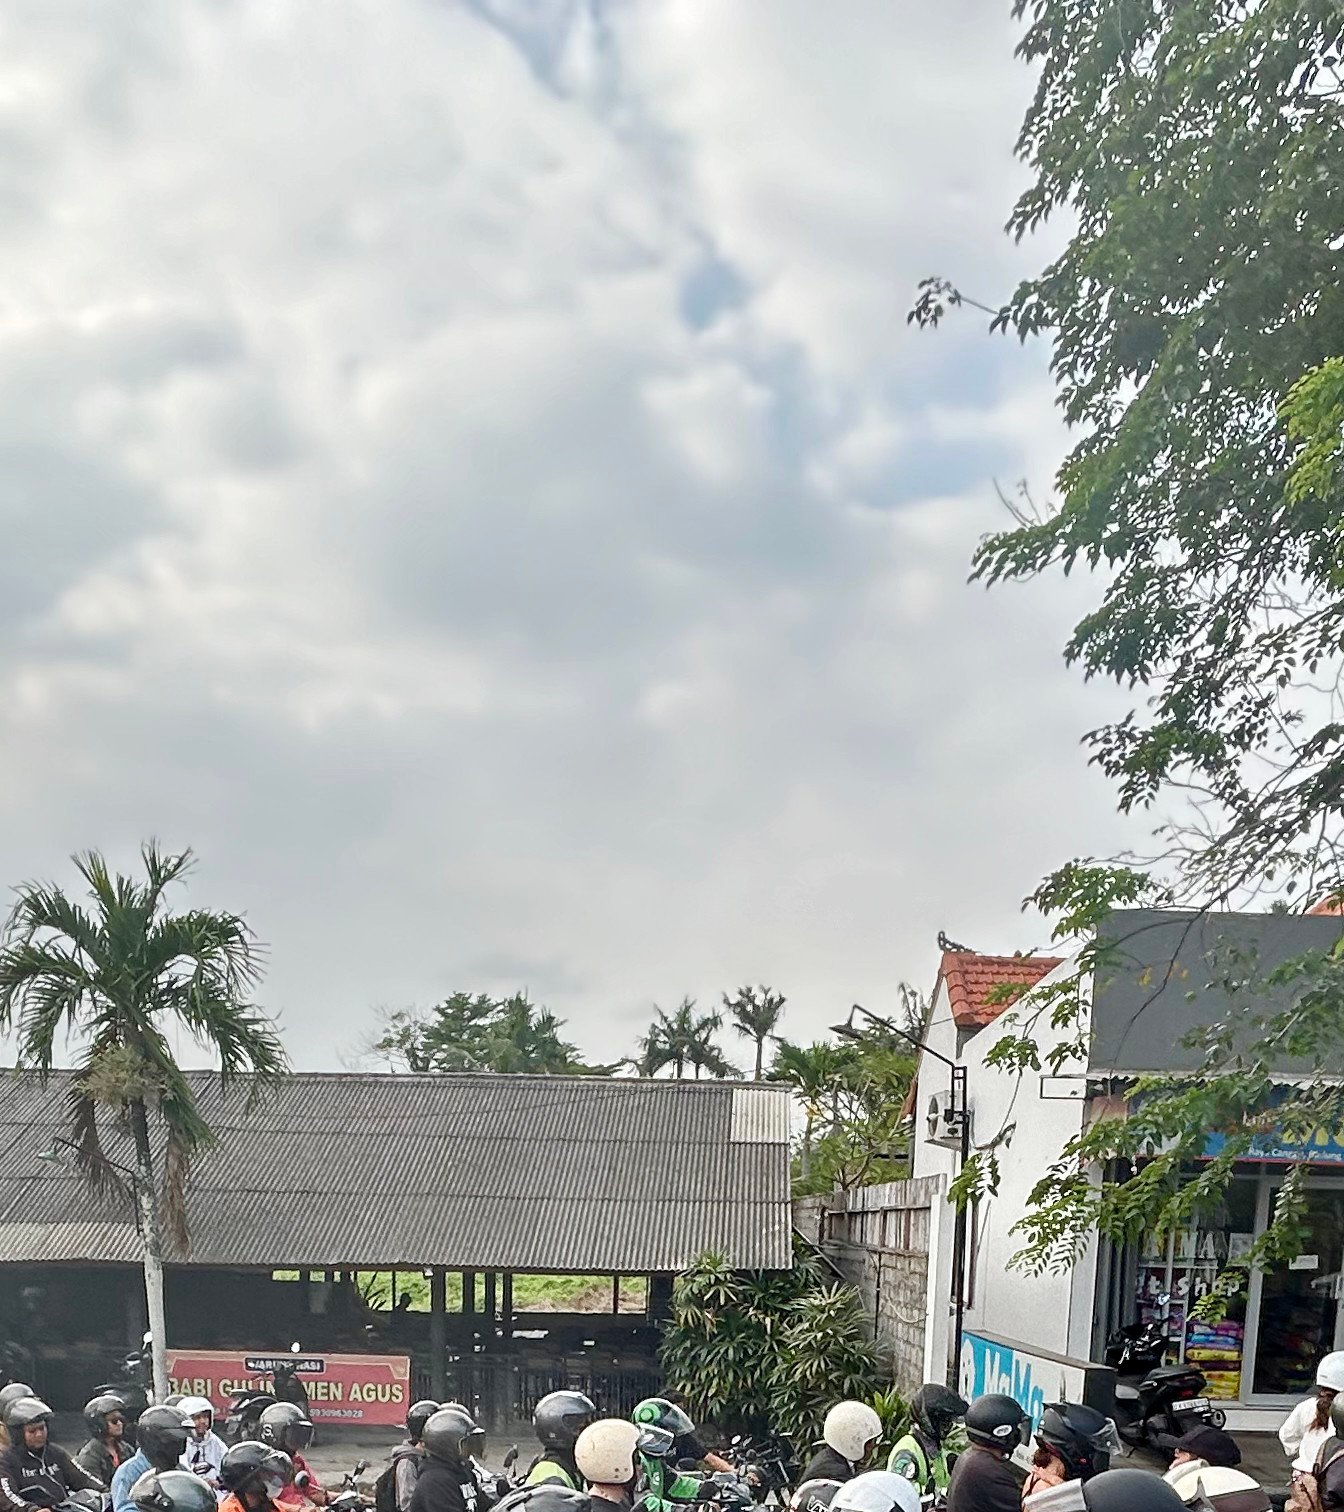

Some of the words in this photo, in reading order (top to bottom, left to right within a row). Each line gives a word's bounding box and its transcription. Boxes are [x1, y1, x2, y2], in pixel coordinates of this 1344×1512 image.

[169, 1377, 212, 1397] BABI
[304, 1381, 343, 1401] MEN
[349, 1382, 404, 1403] AGUS
